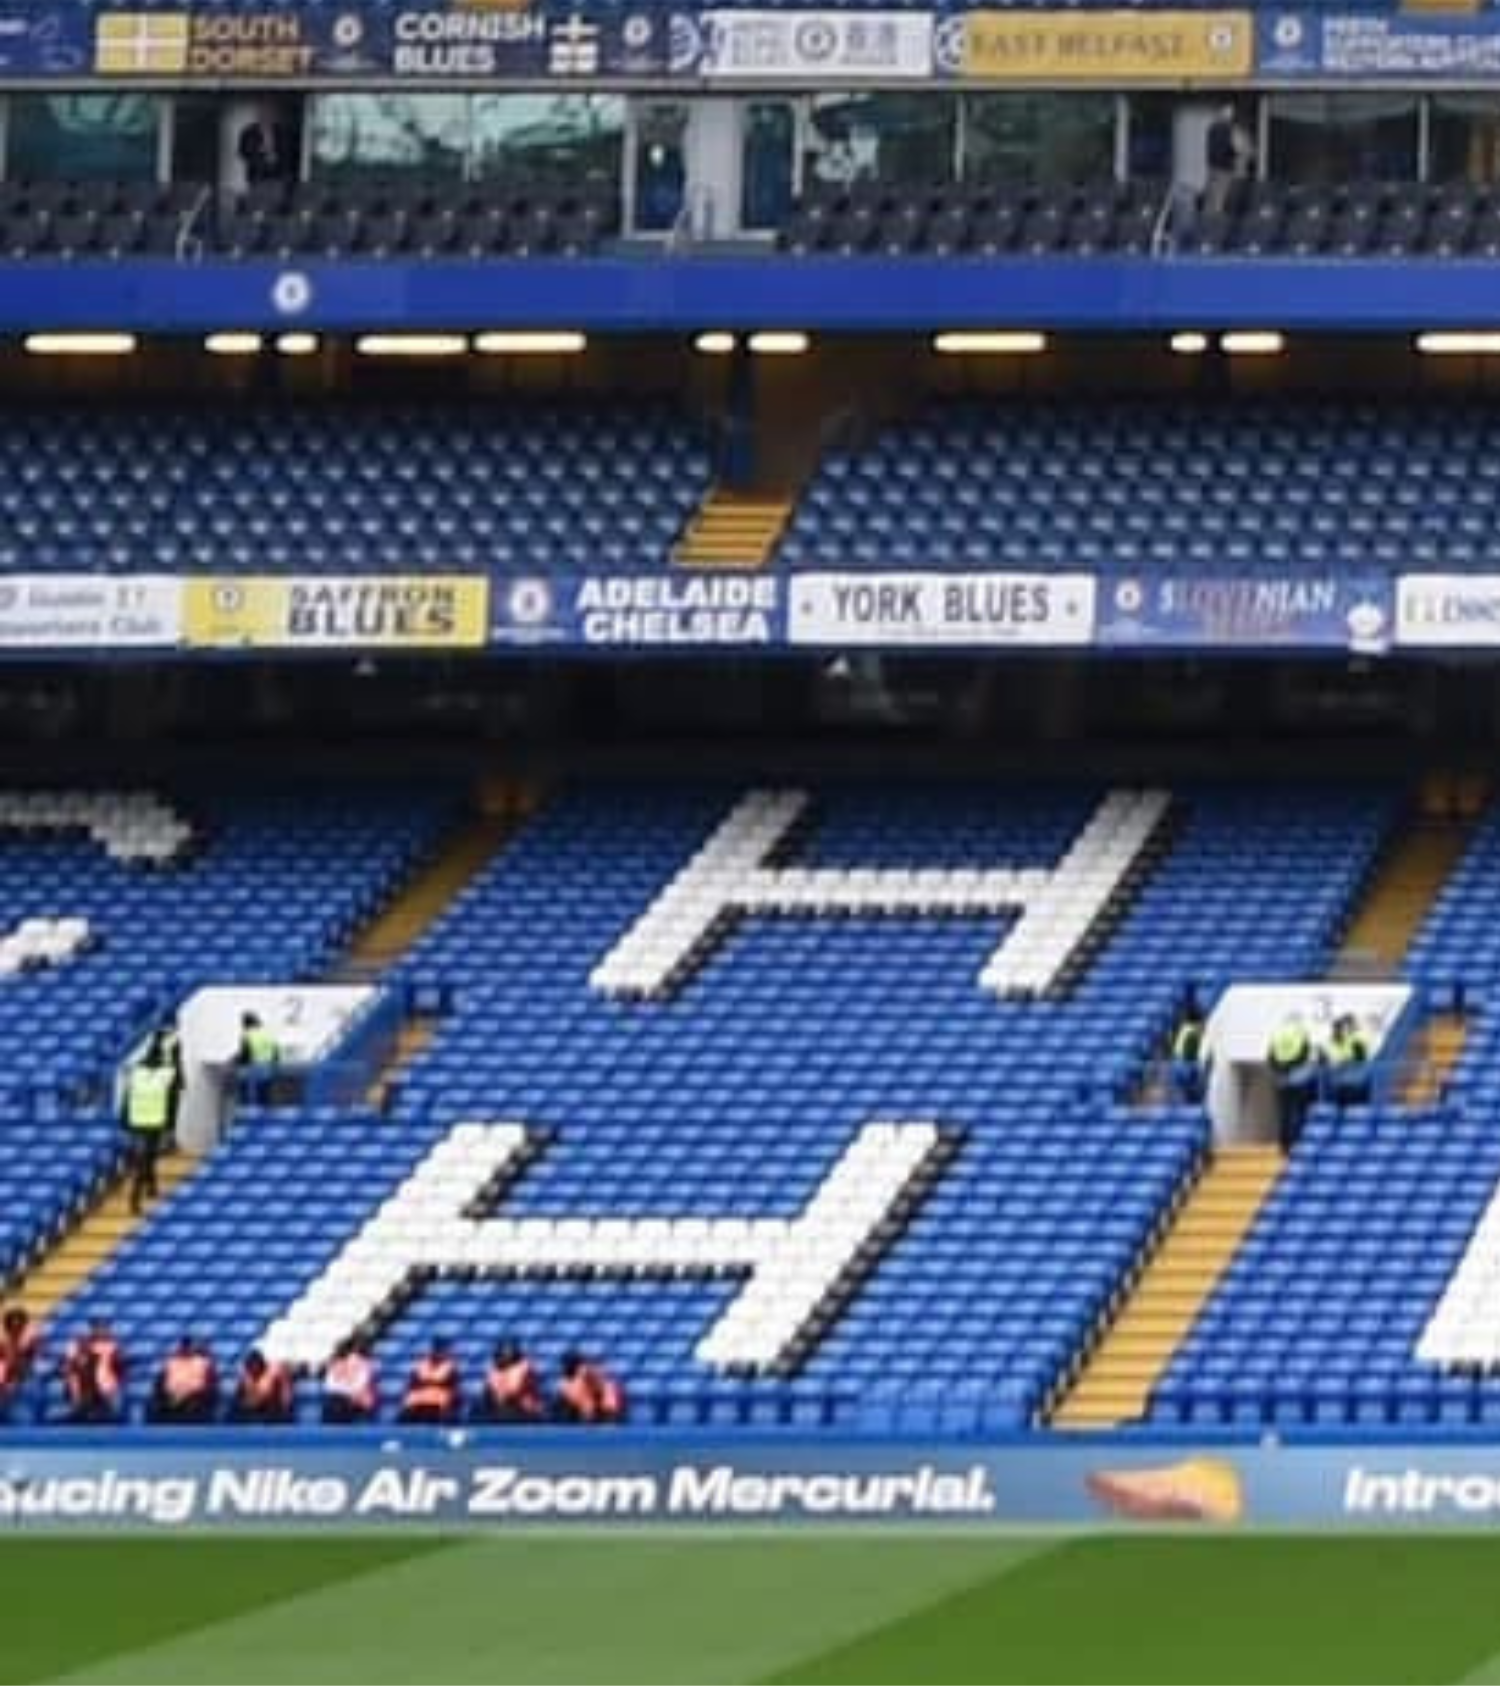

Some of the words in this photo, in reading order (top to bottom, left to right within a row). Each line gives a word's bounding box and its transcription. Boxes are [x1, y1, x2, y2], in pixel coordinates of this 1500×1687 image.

[196, 14, 299, 39] SOUTH
[394, 12, 546, 40] CORNISH
[394, 44, 496, 72] BLUES
[1057, 32, 1183, 57] BELFAST
[191, 45, 313, 73] DORSET
[291, 584, 454, 603] SAFFRON
[575, 576, 776, 610] ADELAIDE
[832, 583, 923, 623] YORK
[943, 583, 1050, 623] BLUES
[289, 607, 455, 636] BLUES
[583, 611, 769, 643] CHELSEA
[205, 1468, 346, 1514] Nike
[354, 1467, 458, 1513] Air
[467, 1466, 658, 1513] Zoom
[667, 1464, 996, 1512] Mercurial.
